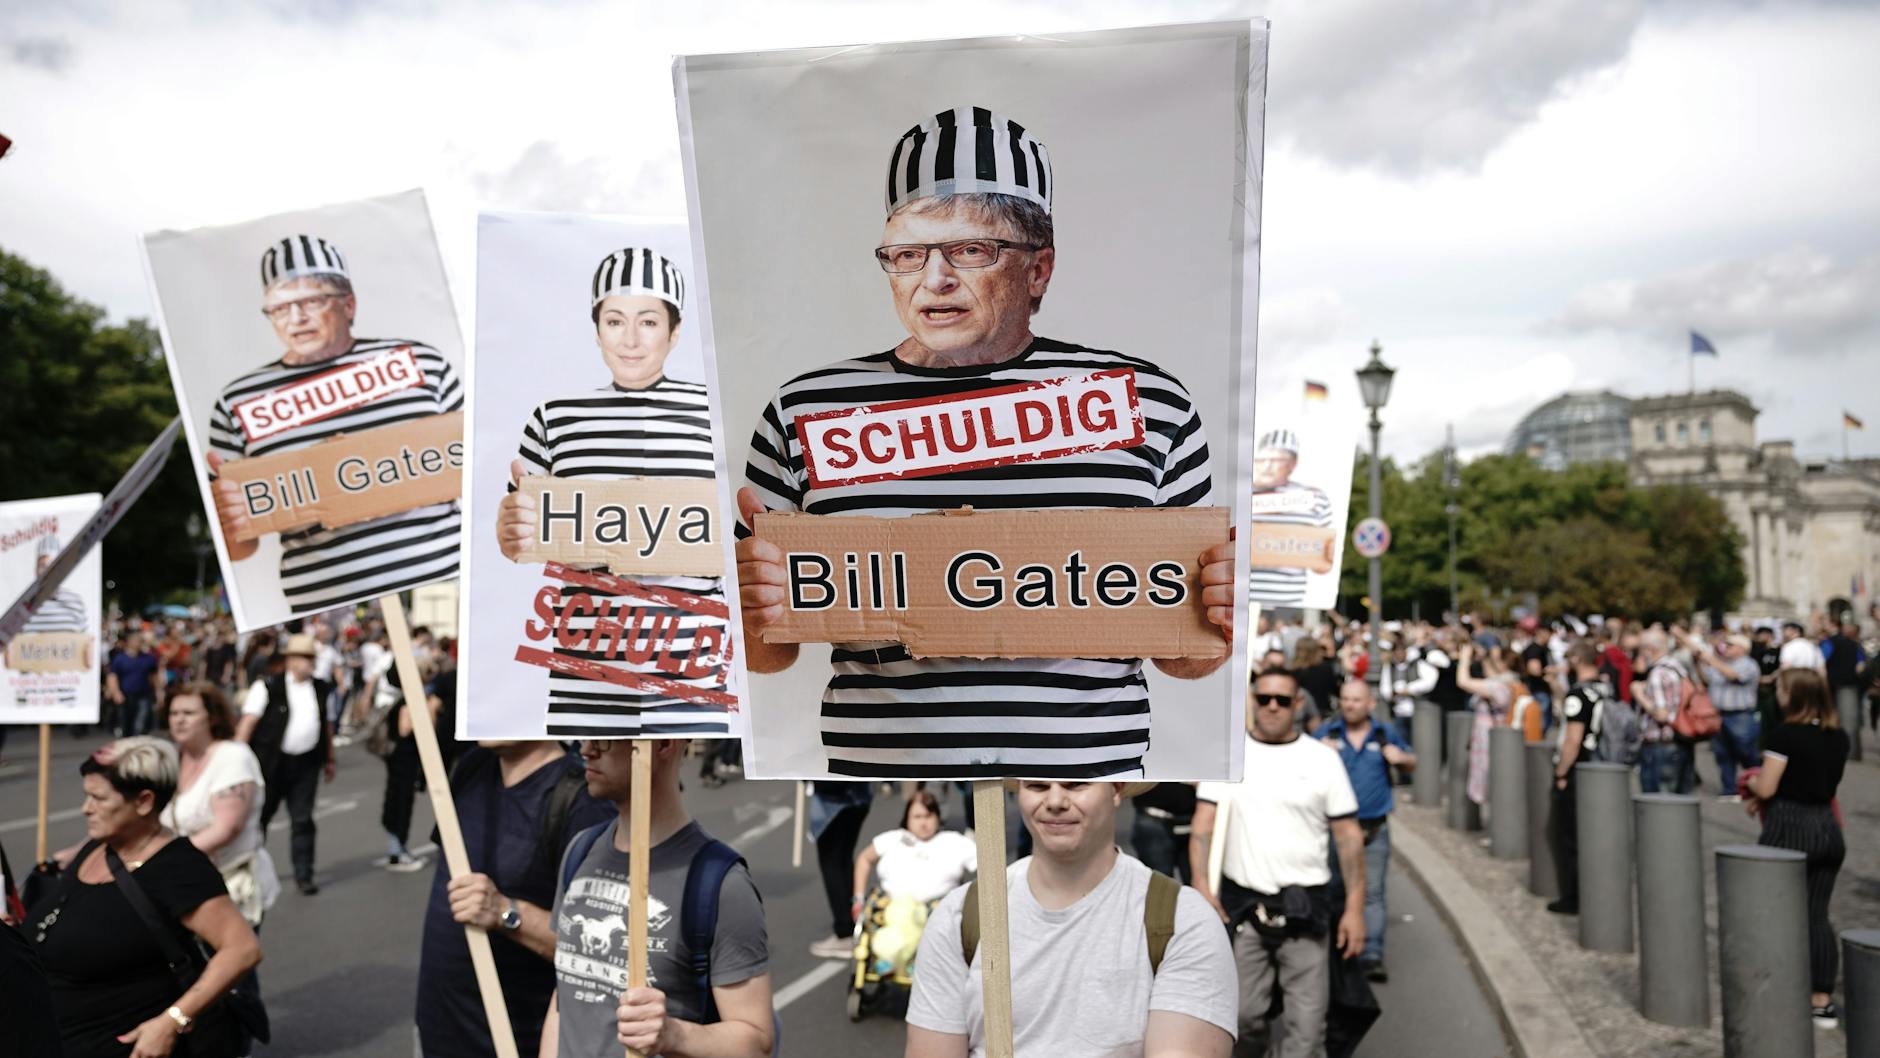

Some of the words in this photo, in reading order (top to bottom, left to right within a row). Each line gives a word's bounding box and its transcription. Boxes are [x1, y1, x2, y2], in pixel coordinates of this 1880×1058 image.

[251, 359, 408, 428] SCHULDIG
[822, 389, 1118, 469] SCHULDIG
[244, 469, 317, 515] Bill
[337, 442, 463, 491] Gates
[541, 492, 711, 557] Haya
[788, 553, 907, 609] Bill
[946, 551, 1187, 609] Gates
[20, 640, 77, 661] Merkel
[559, 955, 627, 983] JEANS
